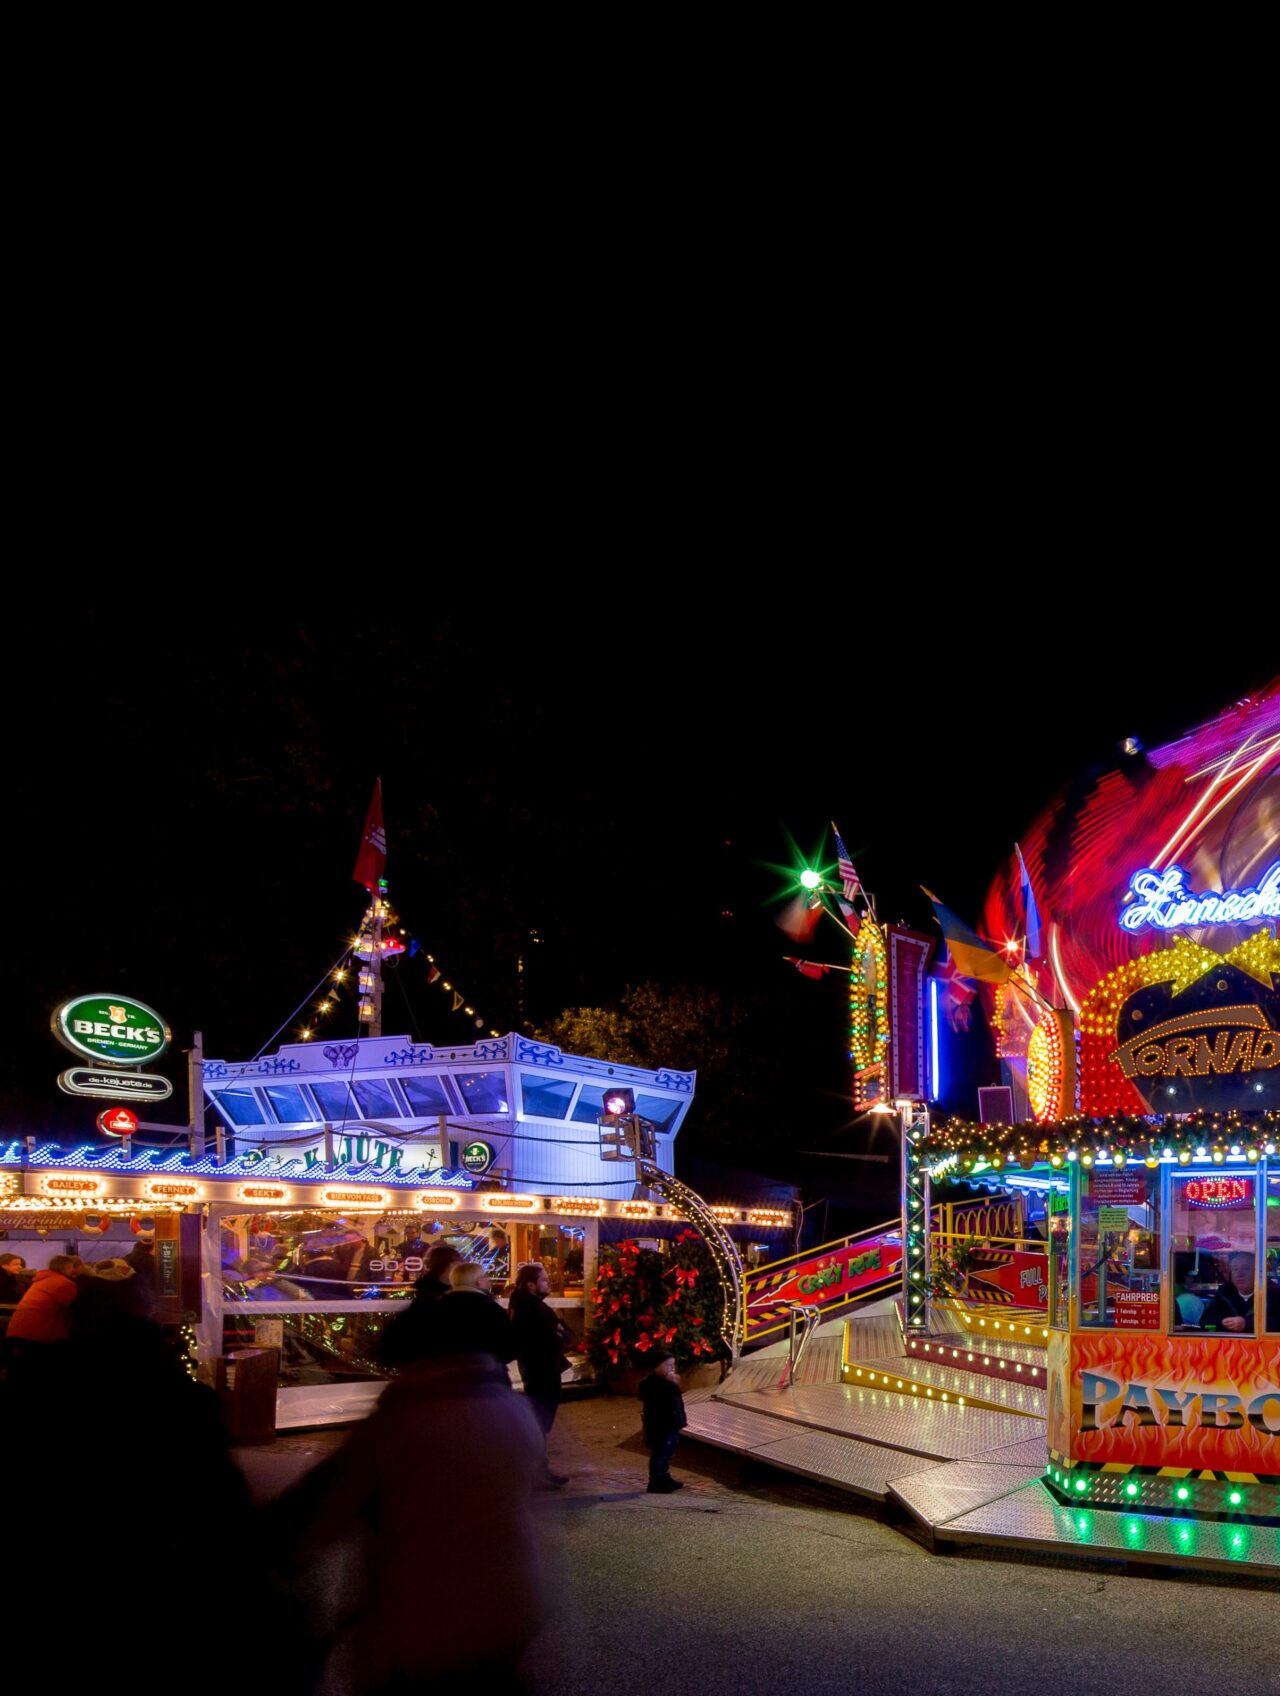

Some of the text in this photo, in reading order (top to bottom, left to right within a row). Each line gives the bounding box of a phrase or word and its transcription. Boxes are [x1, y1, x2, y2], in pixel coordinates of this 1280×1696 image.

[74, 1019, 160, 1044] BECK'S
[87, 1037, 148, 1050] BREMEN GERMANY
[303, 1131, 404, 1171] KJÜTE
[53, 1180, 95, 1190] BAILEY'S
[157, 1185, 192, 1194] FERNET
[252, 1189, 276, 1197] SEKT
[1186, 1180, 1247, 1199] OPEN
[797, 1247, 883, 1295] CRAZY RIDE
[1020, 1266, 1043, 1289] FULL
[1116, 1292, 1158, 1302] FAHRPREIS
